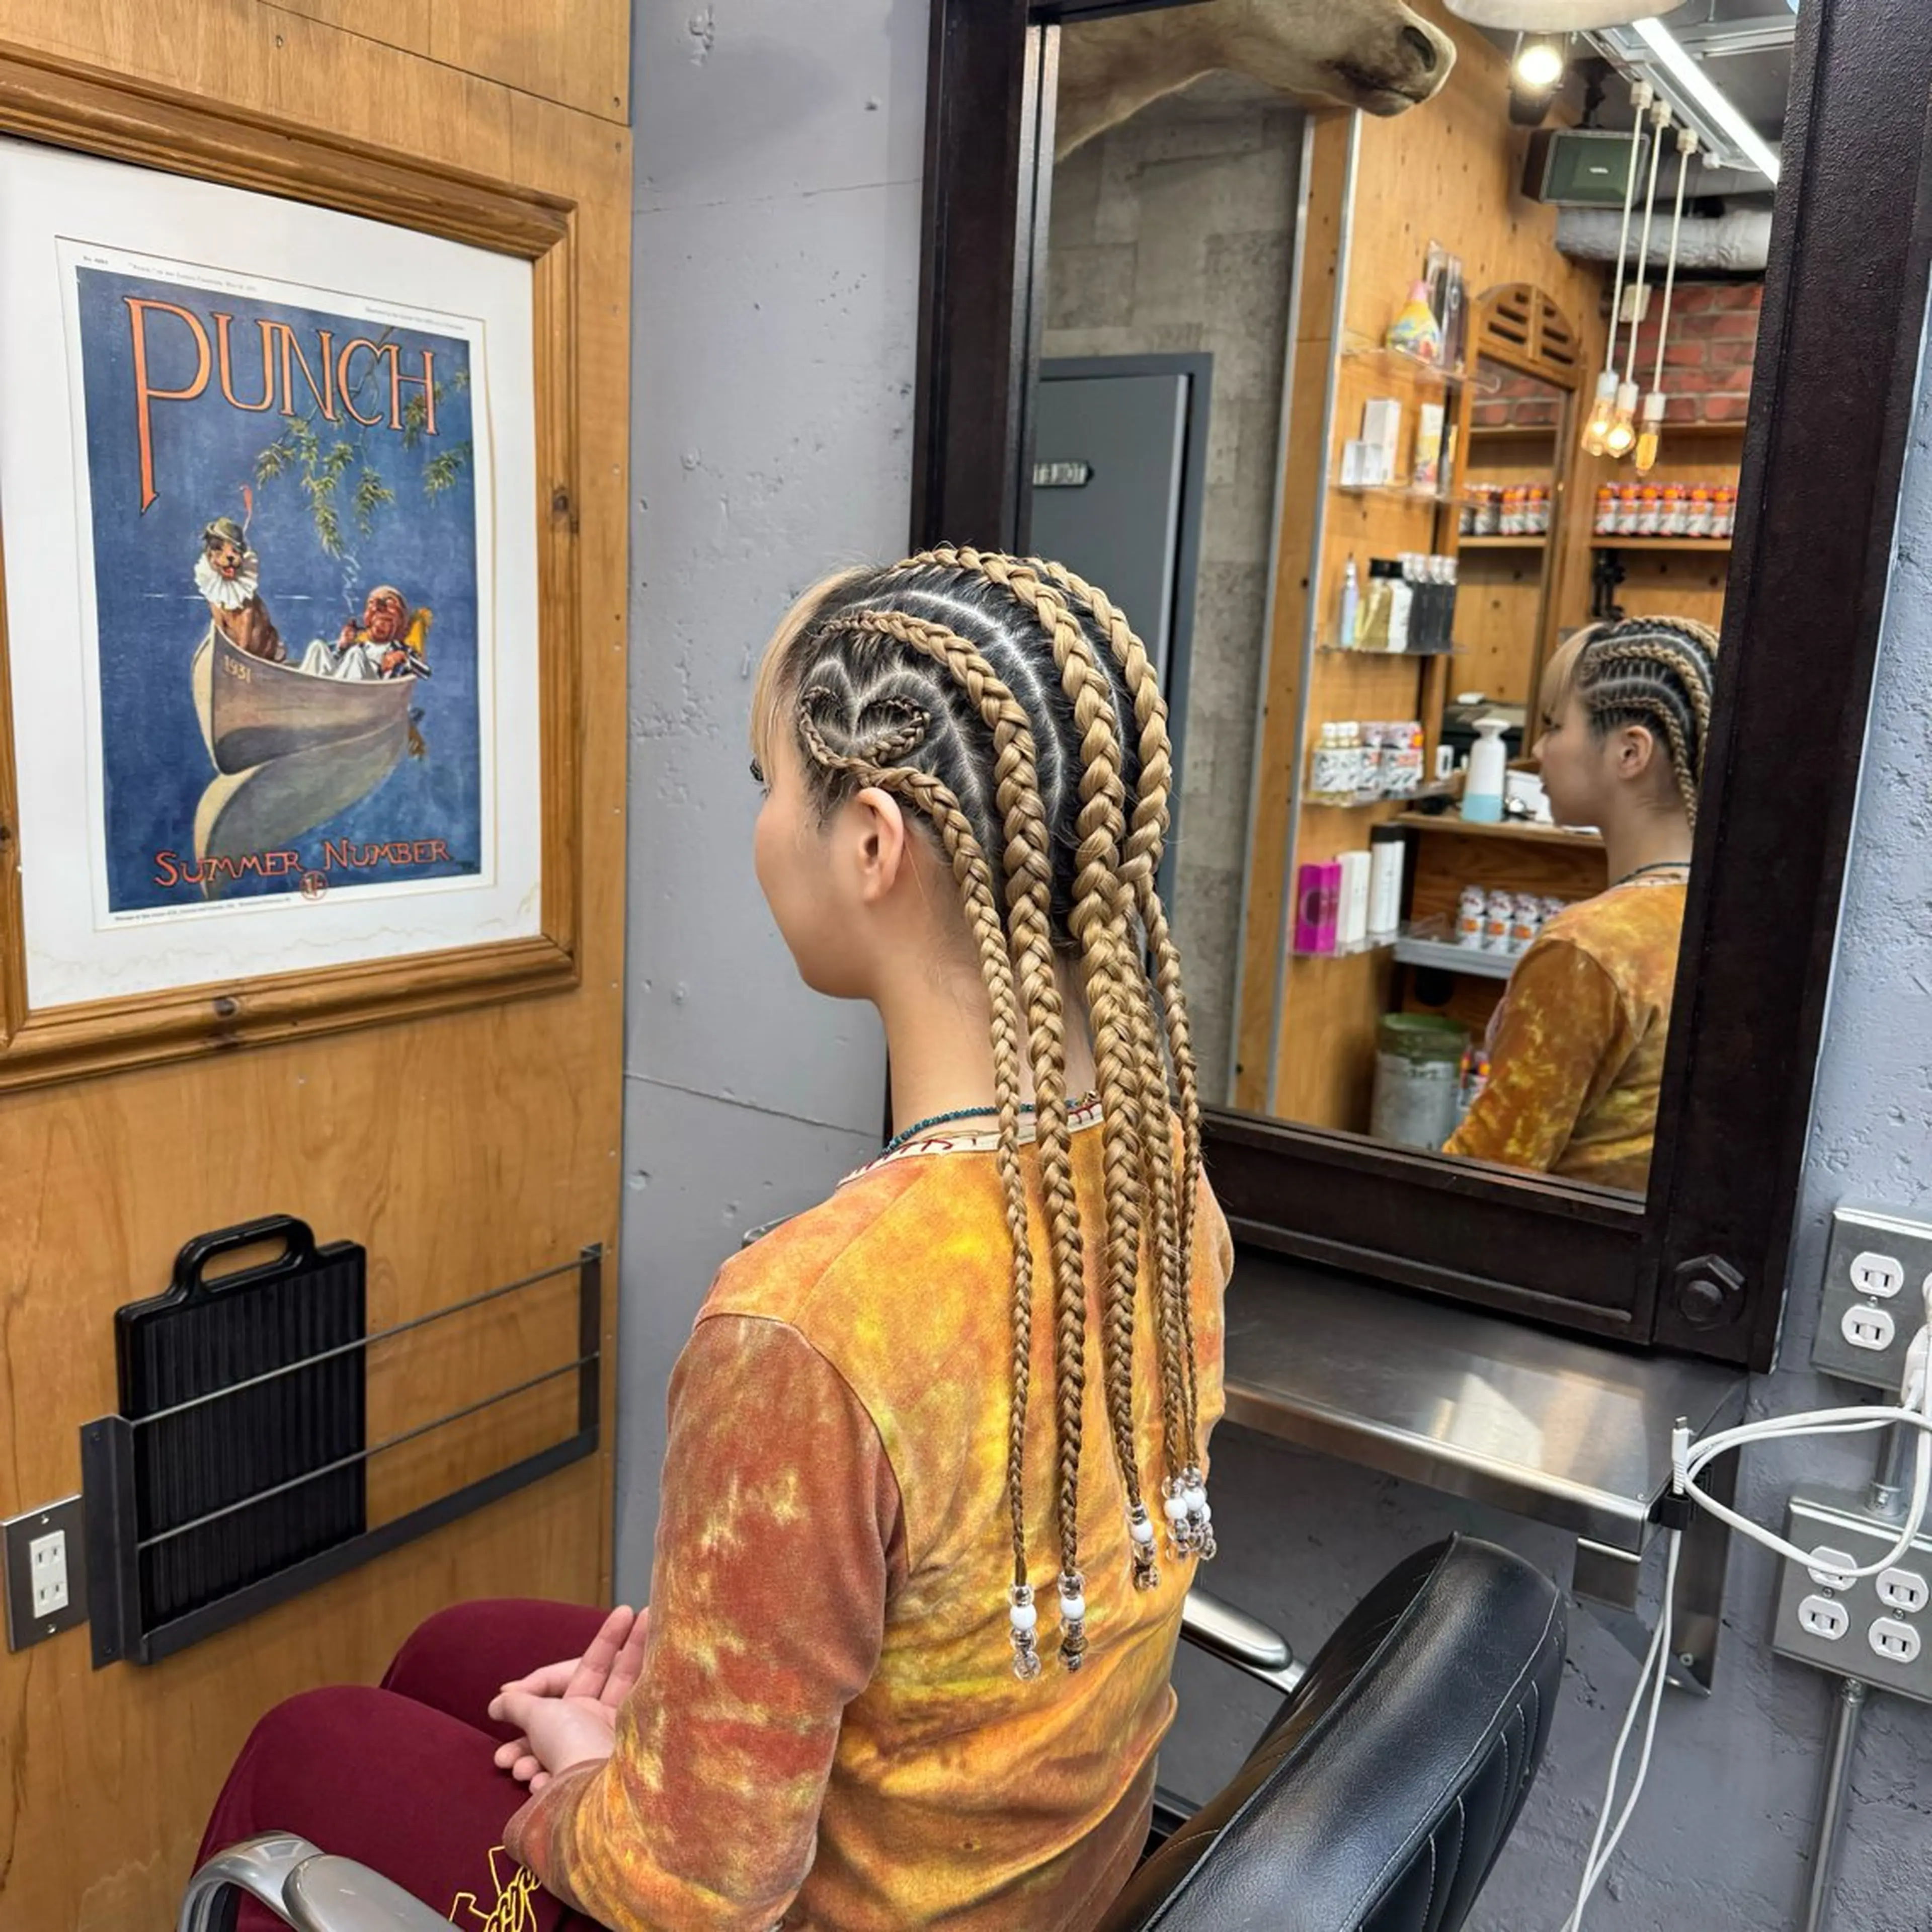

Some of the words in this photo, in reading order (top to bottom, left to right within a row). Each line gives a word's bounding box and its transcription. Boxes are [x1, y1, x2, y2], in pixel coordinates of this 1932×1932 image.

[123, 296, 440, 516] PUNCH
[224, 655, 251, 684] 1931
[153, 850, 304, 887] SUMMER
[323, 836, 451, 872] NUMBER
